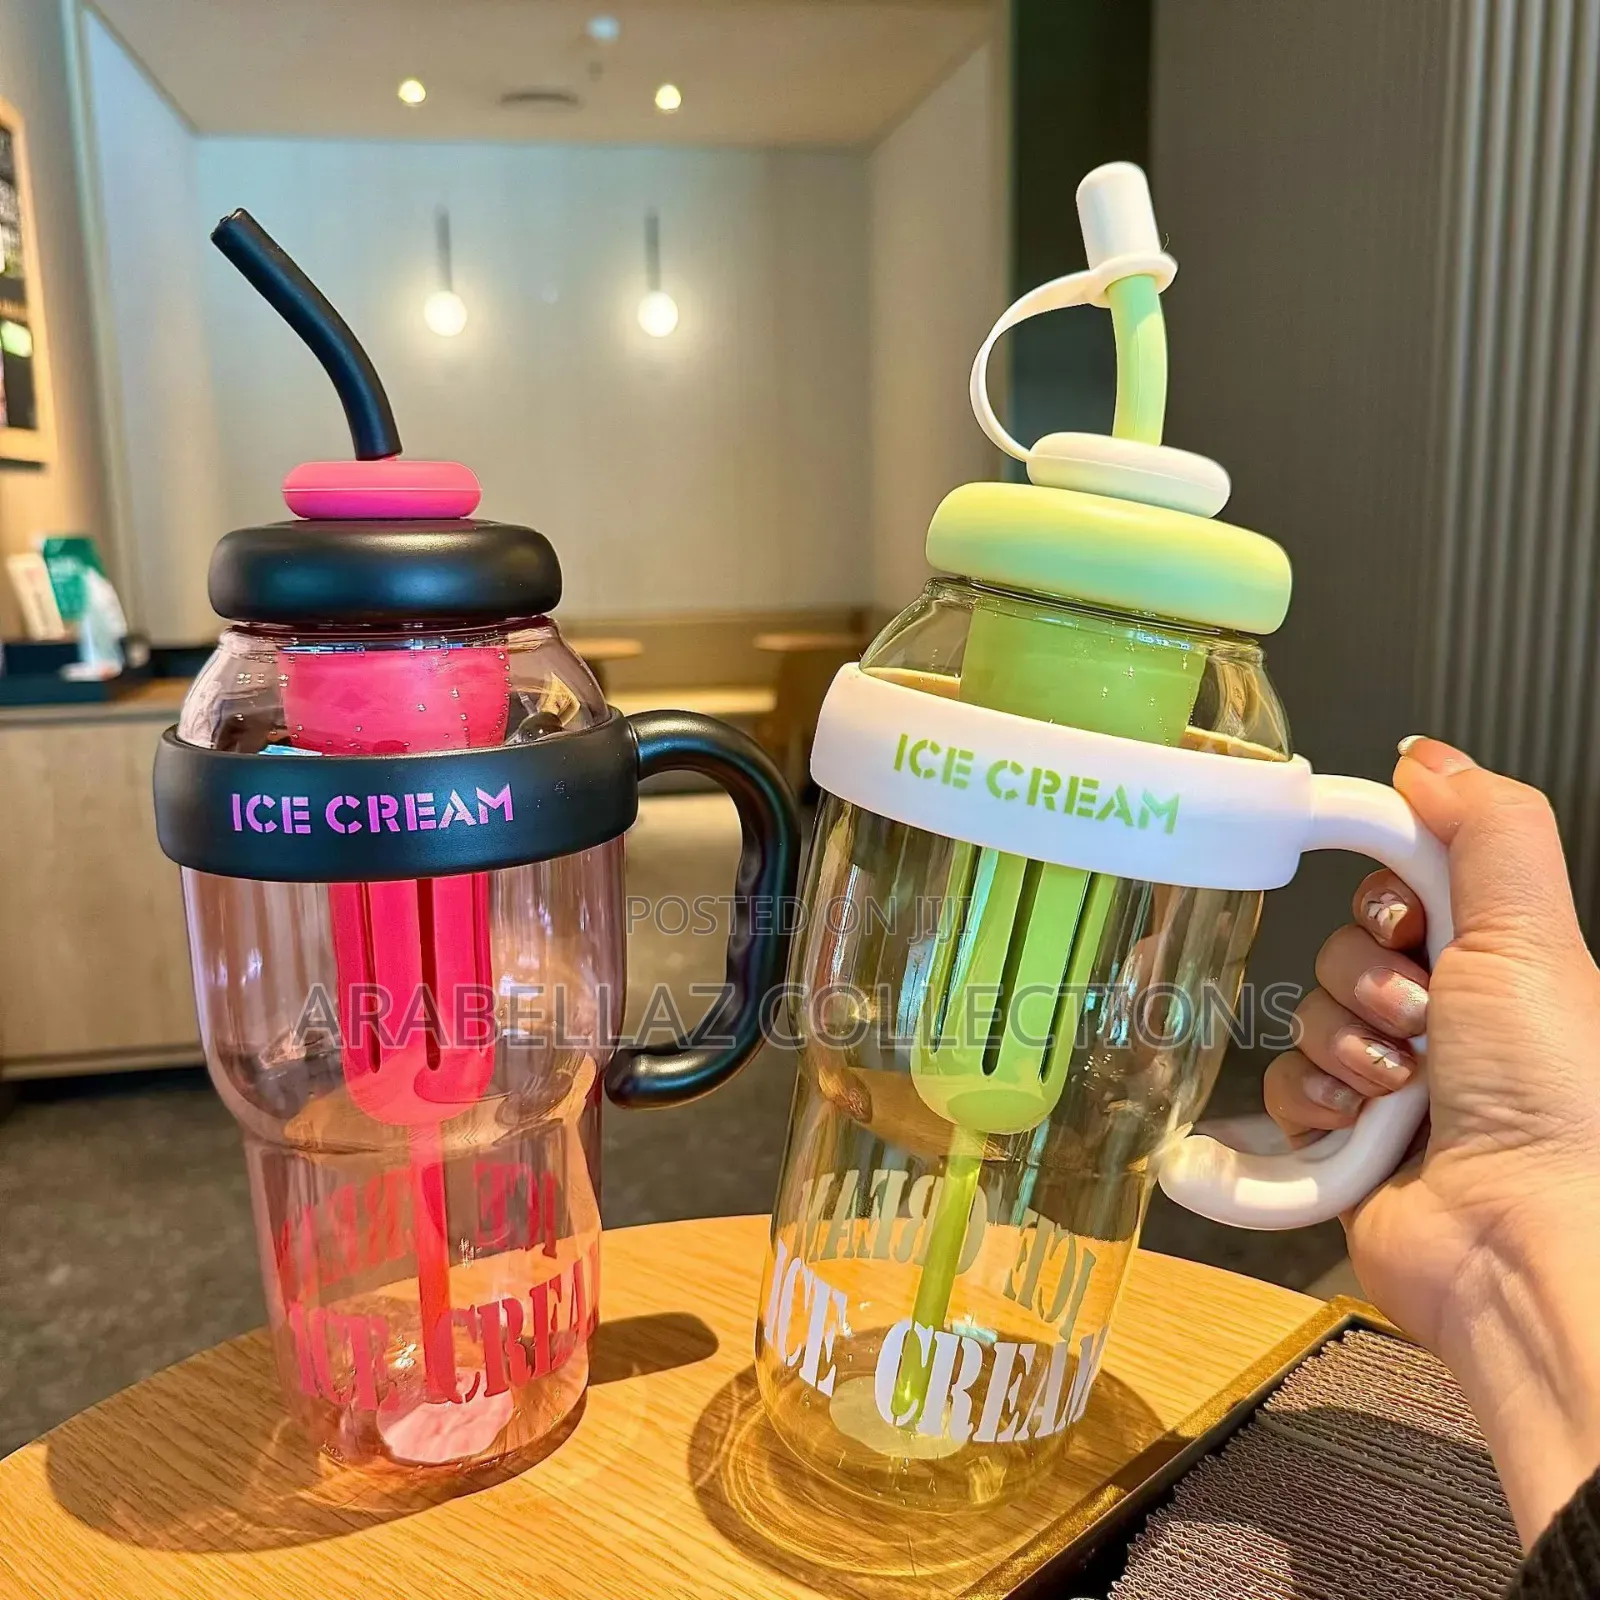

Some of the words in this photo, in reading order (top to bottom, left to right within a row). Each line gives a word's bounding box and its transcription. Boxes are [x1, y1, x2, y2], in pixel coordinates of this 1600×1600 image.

[230, 793, 311, 834] ICE
[325, 783, 514, 834] CREAM
[893, 733, 975, 789] ICE
[985, 759, 1180, 835] CREAM
[764, 1237, 848, 1397] ICE
